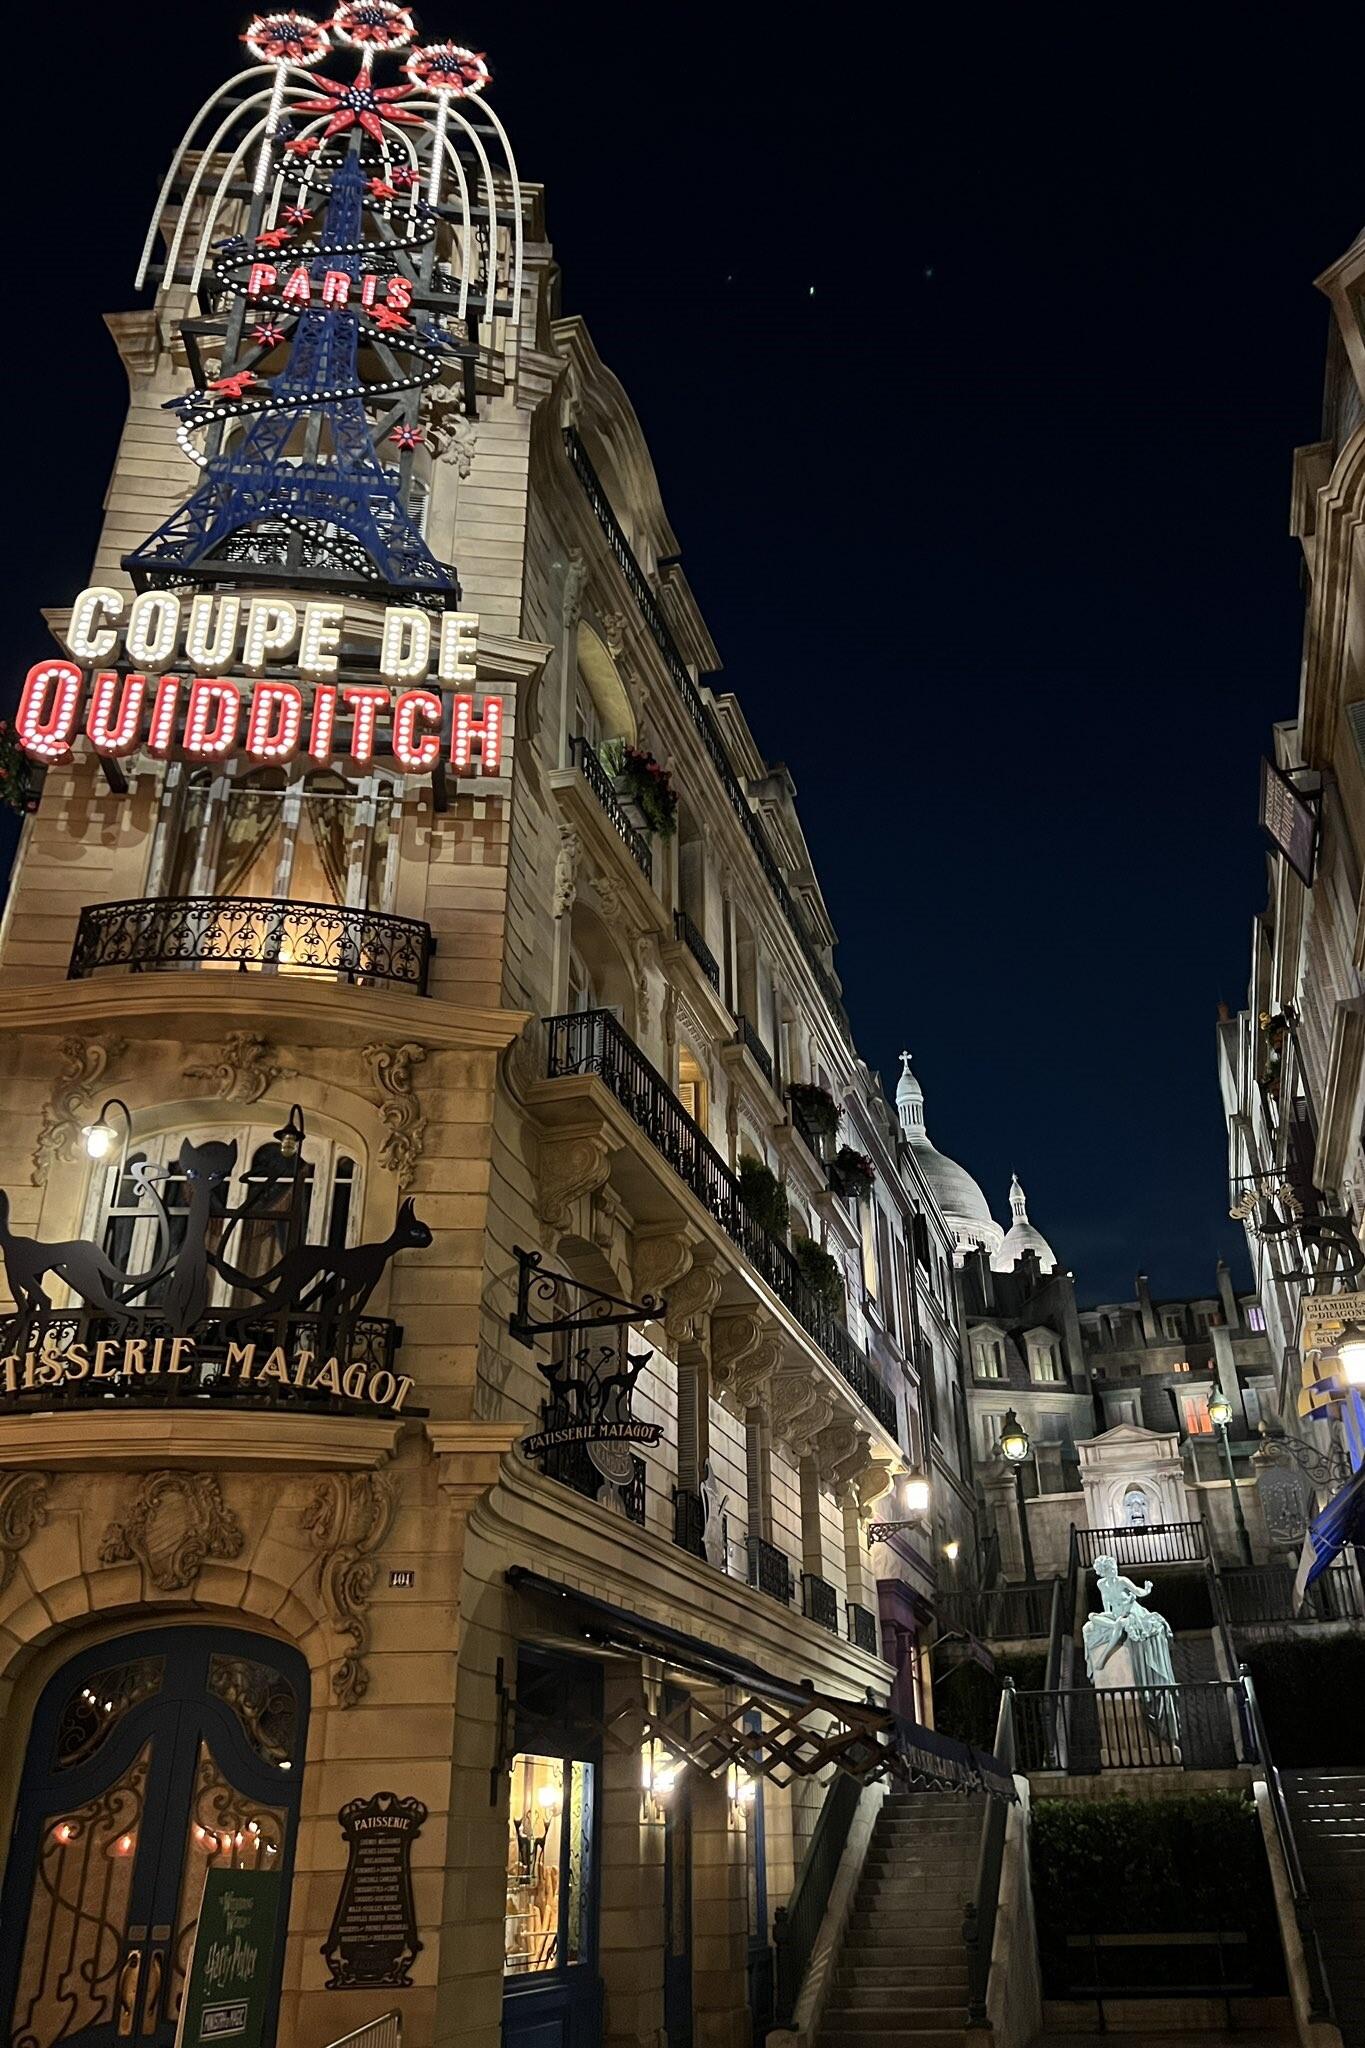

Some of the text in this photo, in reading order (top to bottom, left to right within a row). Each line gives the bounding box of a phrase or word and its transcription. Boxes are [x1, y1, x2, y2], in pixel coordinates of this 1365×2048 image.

[248, 262, 414, 309] PARIS
[66, 586, 480, 689] COUPE DE
[14, 659, 503, 775] QUIDDITCH
[222, 1341, 416, 1411] MATAGOT
[529, 1424, 656, 1451] PATISSERIE MATAGOT
[354, 1816, 411, 1831] PATISSERIE
